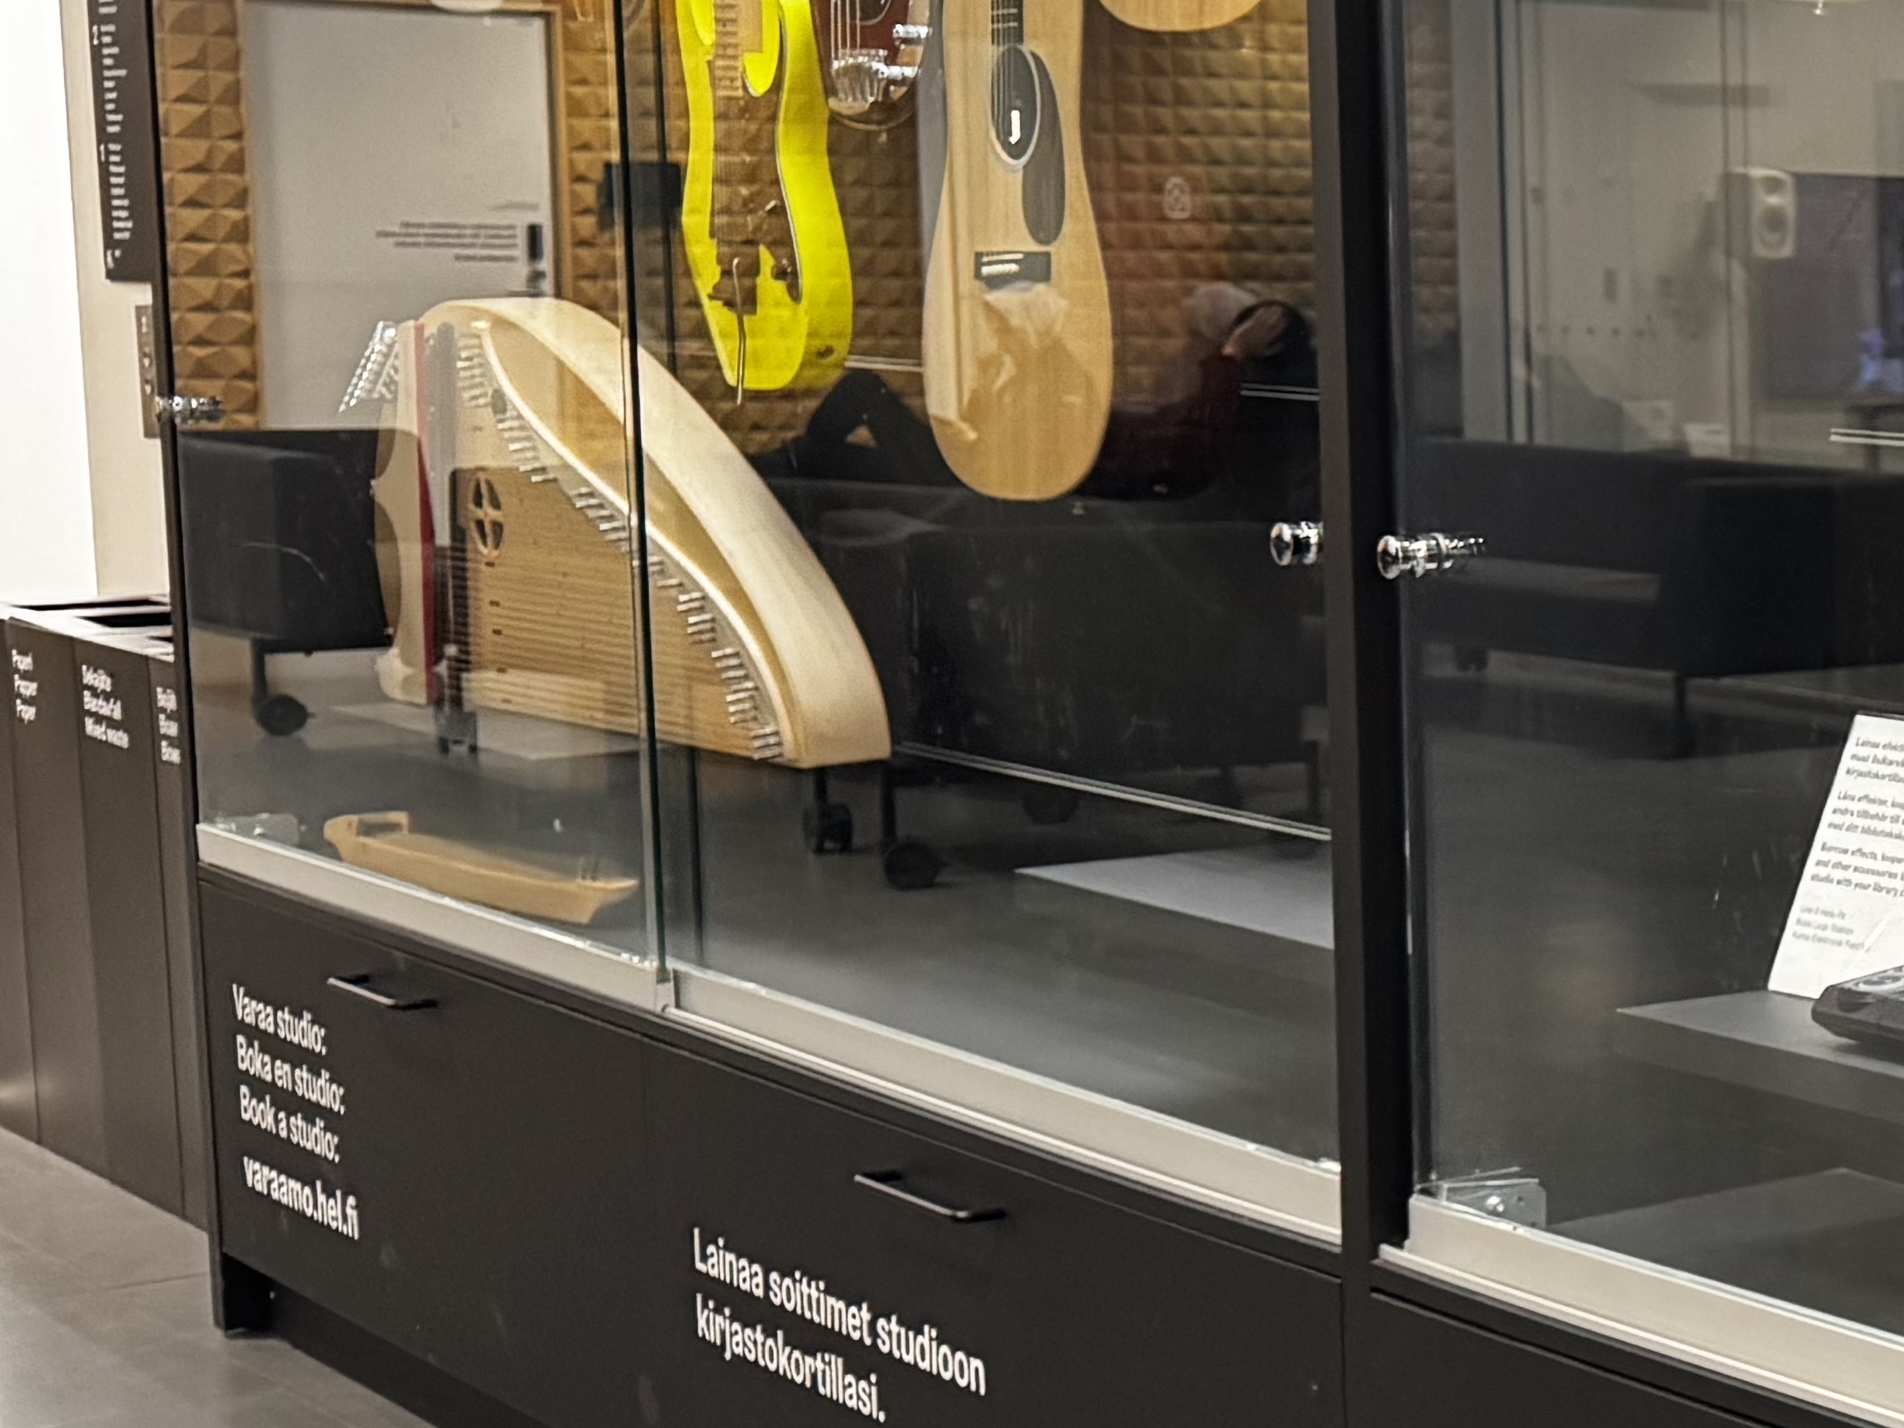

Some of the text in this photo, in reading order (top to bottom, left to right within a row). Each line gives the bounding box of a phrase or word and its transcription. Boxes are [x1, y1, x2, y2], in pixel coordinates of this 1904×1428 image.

[232, 983, 327, 1056] Varaa studio:
[236, 1034, 345, 1115] Boka en studio:
[239, 1084, 340, 1164] Book a studio:
[243, 1156, 359, 1240] varaamo.hel.fi
[693, 1227, 986, 1396] Lainaa soittimet studioon
[696, 1293, 886, 1423] kirjastokortillasi.
